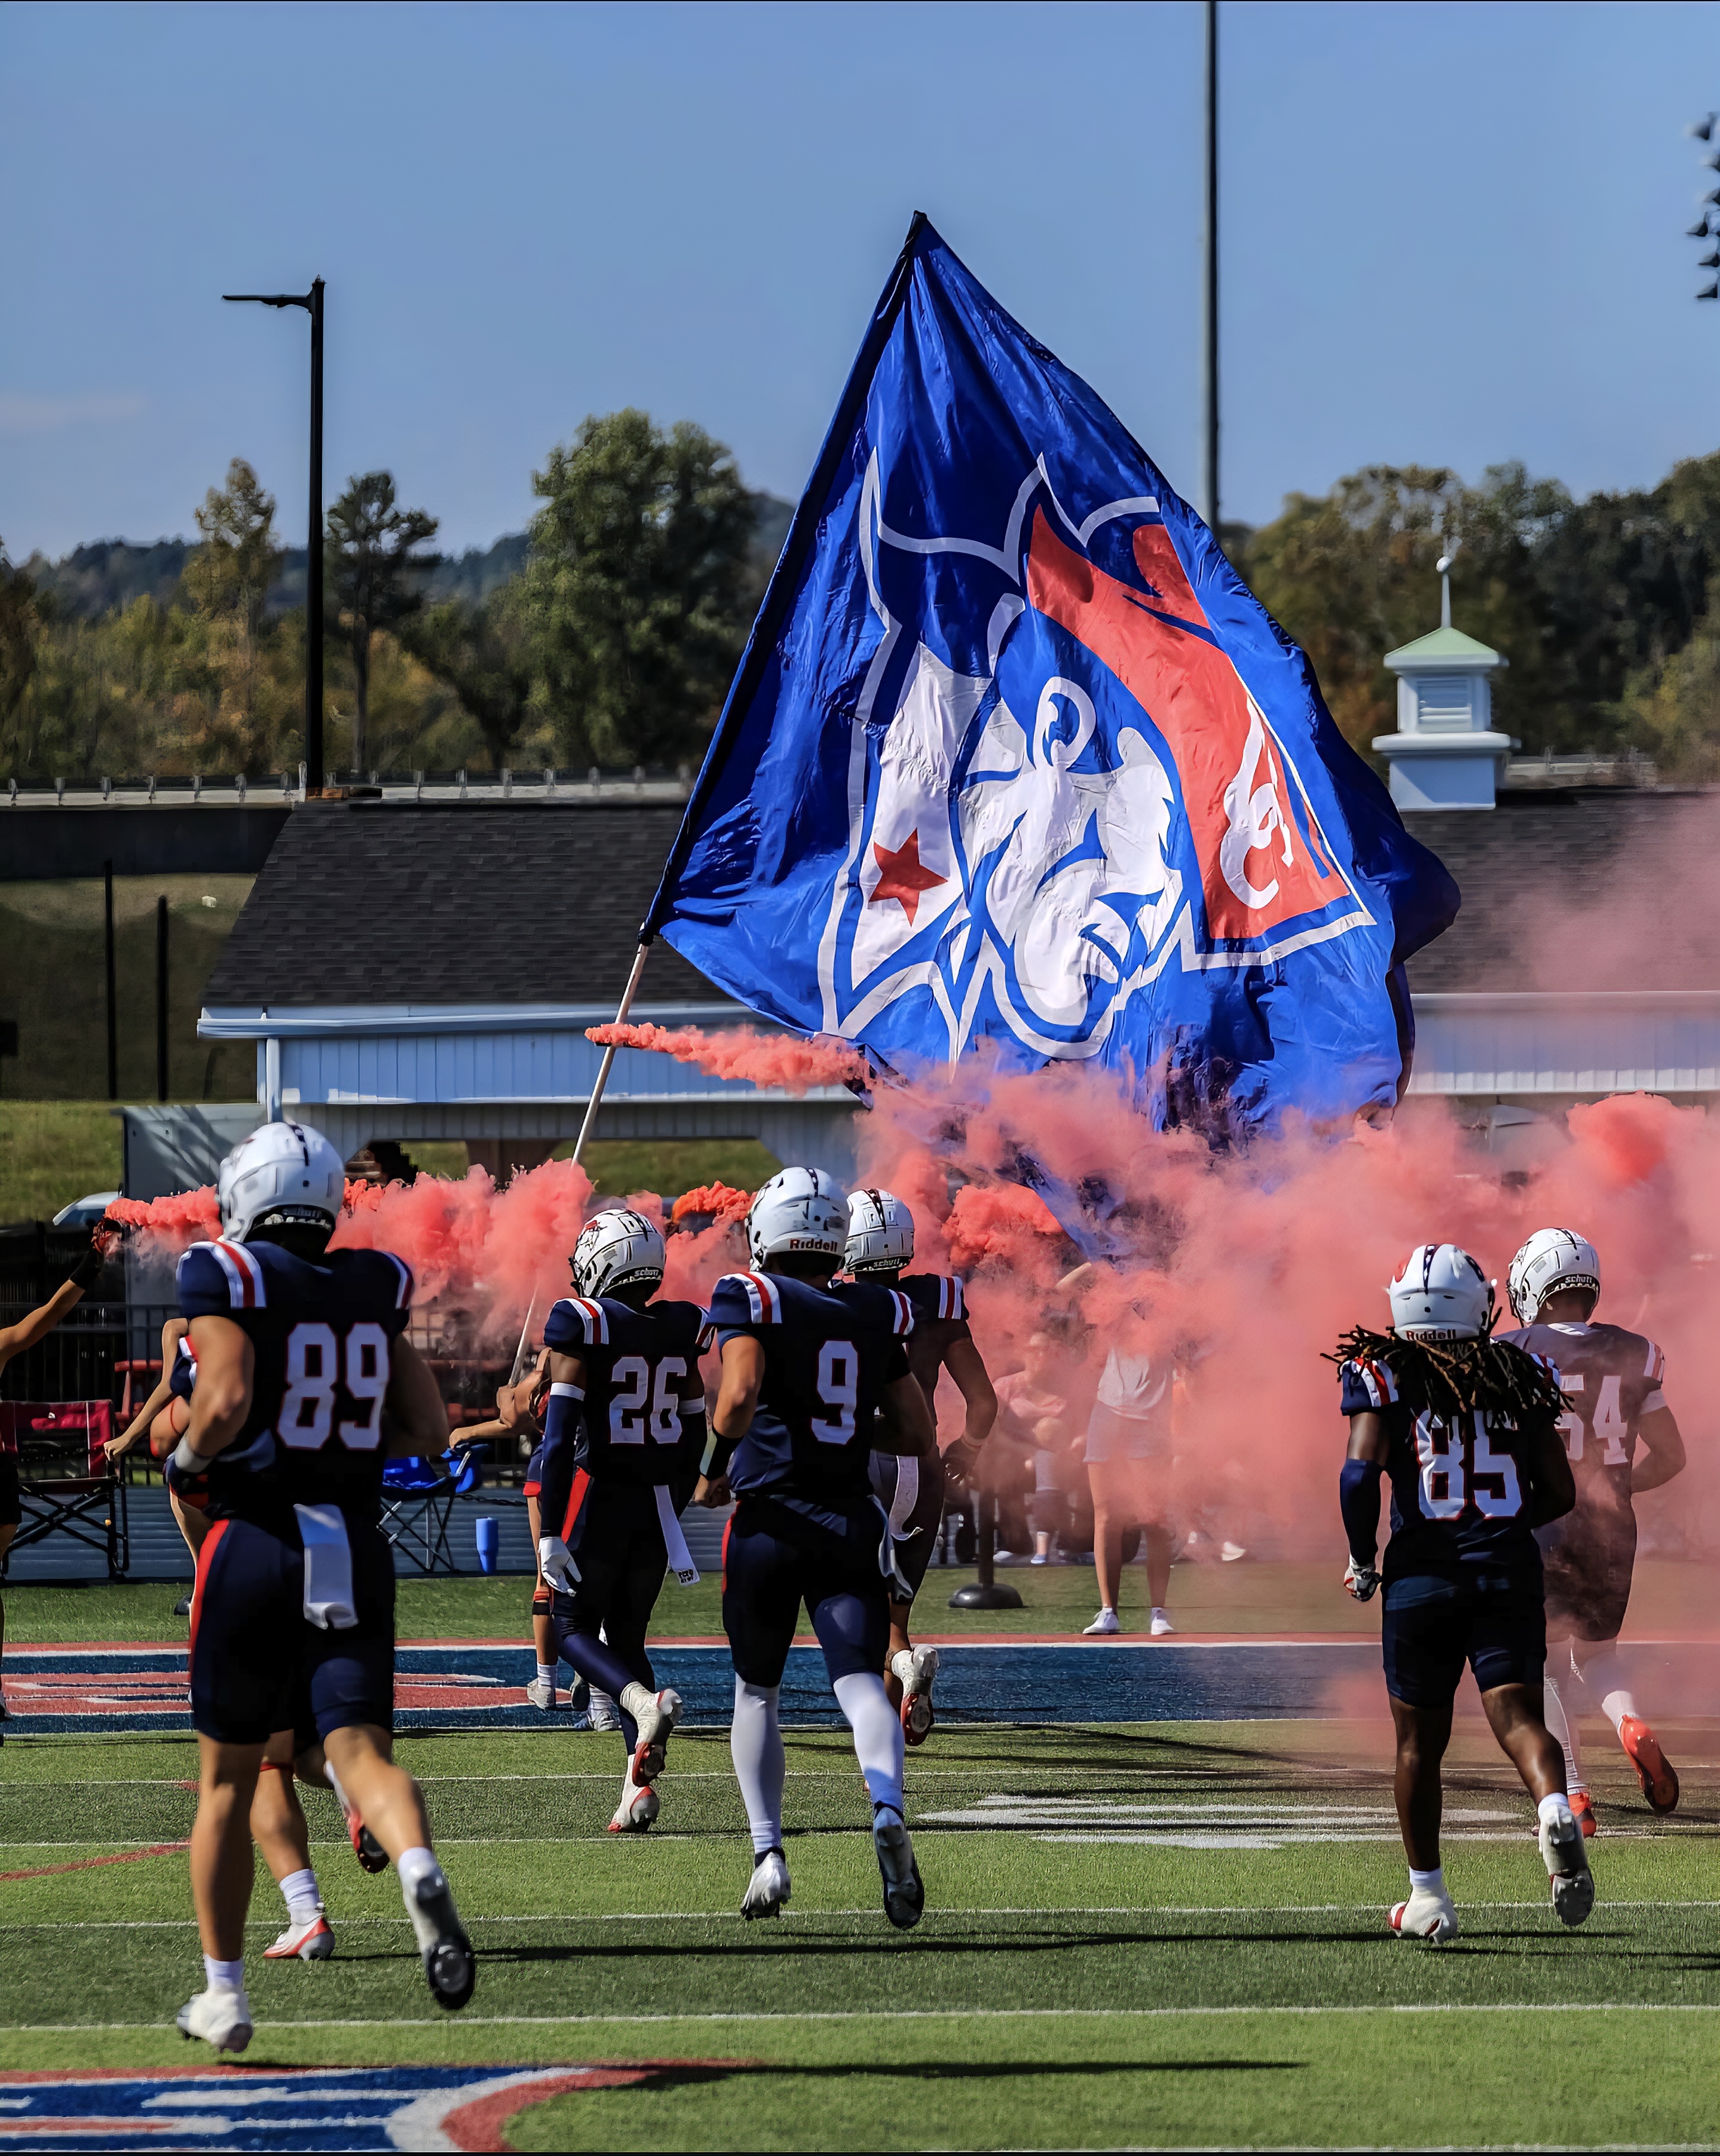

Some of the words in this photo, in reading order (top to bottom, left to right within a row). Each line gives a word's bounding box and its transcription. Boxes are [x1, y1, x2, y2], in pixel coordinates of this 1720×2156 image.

[789, 1238, 838, 1252] Riddell
[277, 1322, 390, 1450] 89
[609, 1356, 687, 1445] 26
[811, 1340, 859, 1446] 9
[1415, 1408, 1523, 1520] 85
